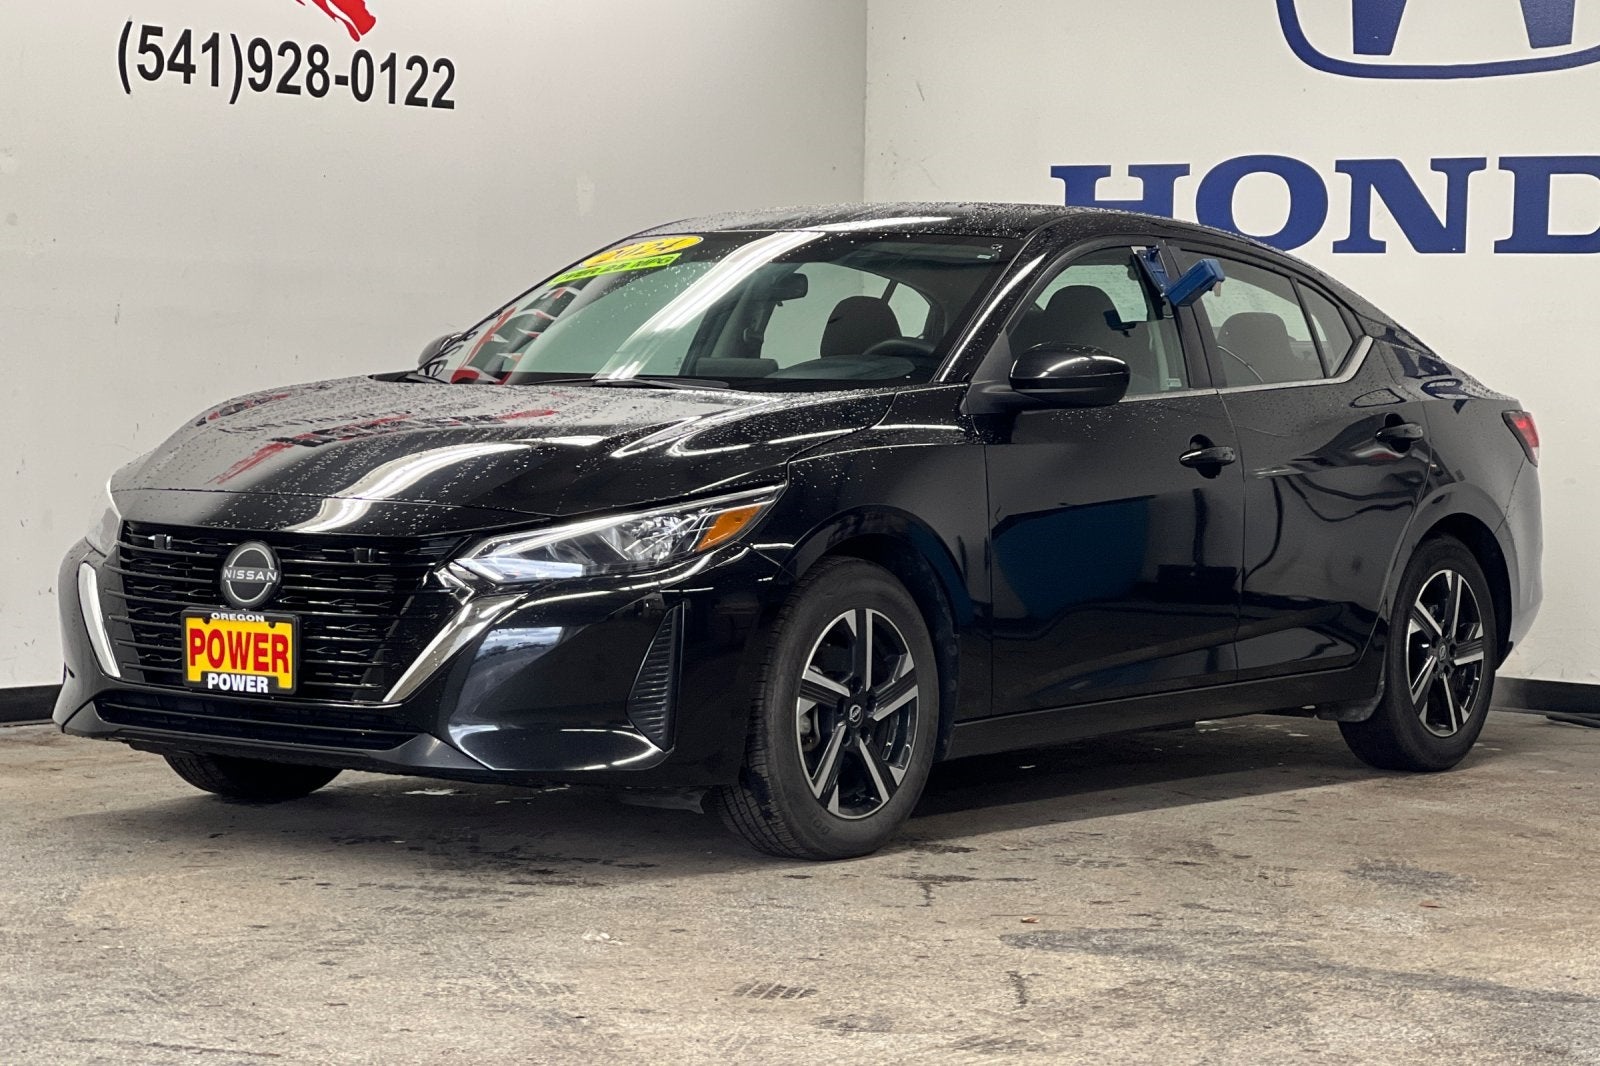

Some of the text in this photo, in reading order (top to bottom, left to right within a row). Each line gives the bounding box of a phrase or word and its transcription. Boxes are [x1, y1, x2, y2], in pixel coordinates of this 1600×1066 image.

[117, 20, 455, 110] (541)928-0122
[223, 569, 278, 582] NISSAN
[210, 612, 265, 623] OREGON
[189, 627, 290, 674] POWER
[207, 672, 269, 694] POWER
